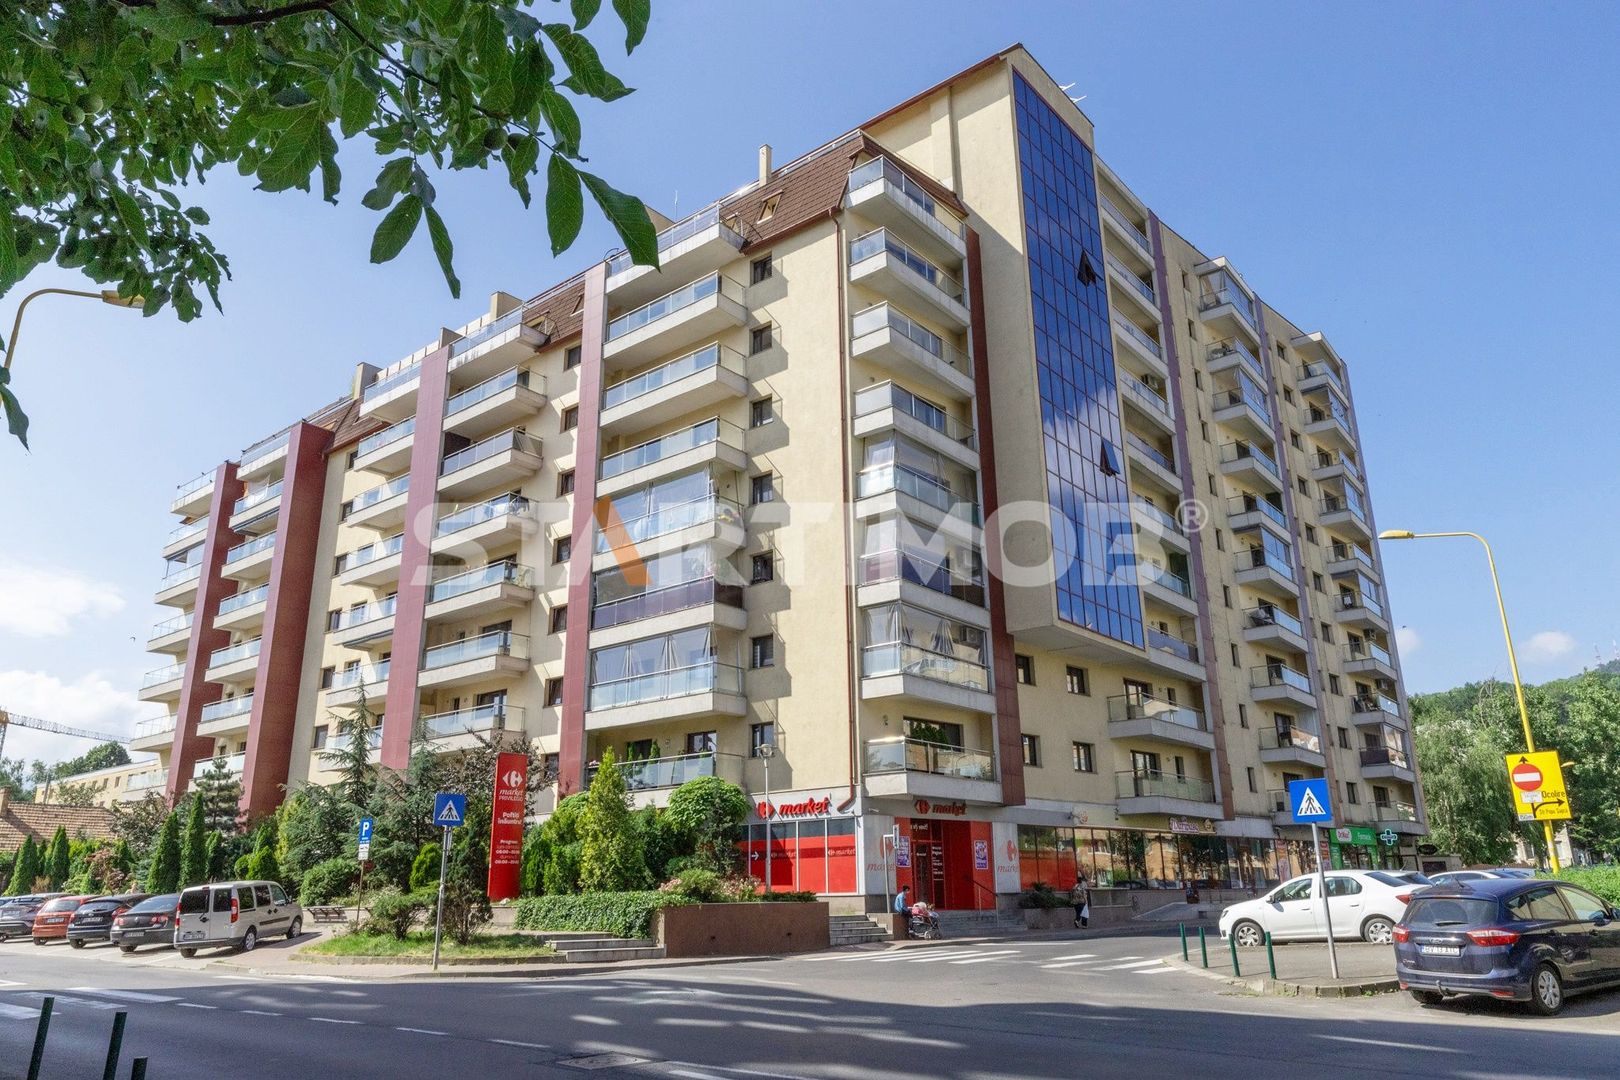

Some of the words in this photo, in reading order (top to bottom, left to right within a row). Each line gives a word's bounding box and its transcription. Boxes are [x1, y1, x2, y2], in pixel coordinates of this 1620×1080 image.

[1541, 790, 1566, 799] Ocolire
[779, 797, 830, 816] market
[932, 800, 968, 817] market
[835, 847, 856, 856] market
